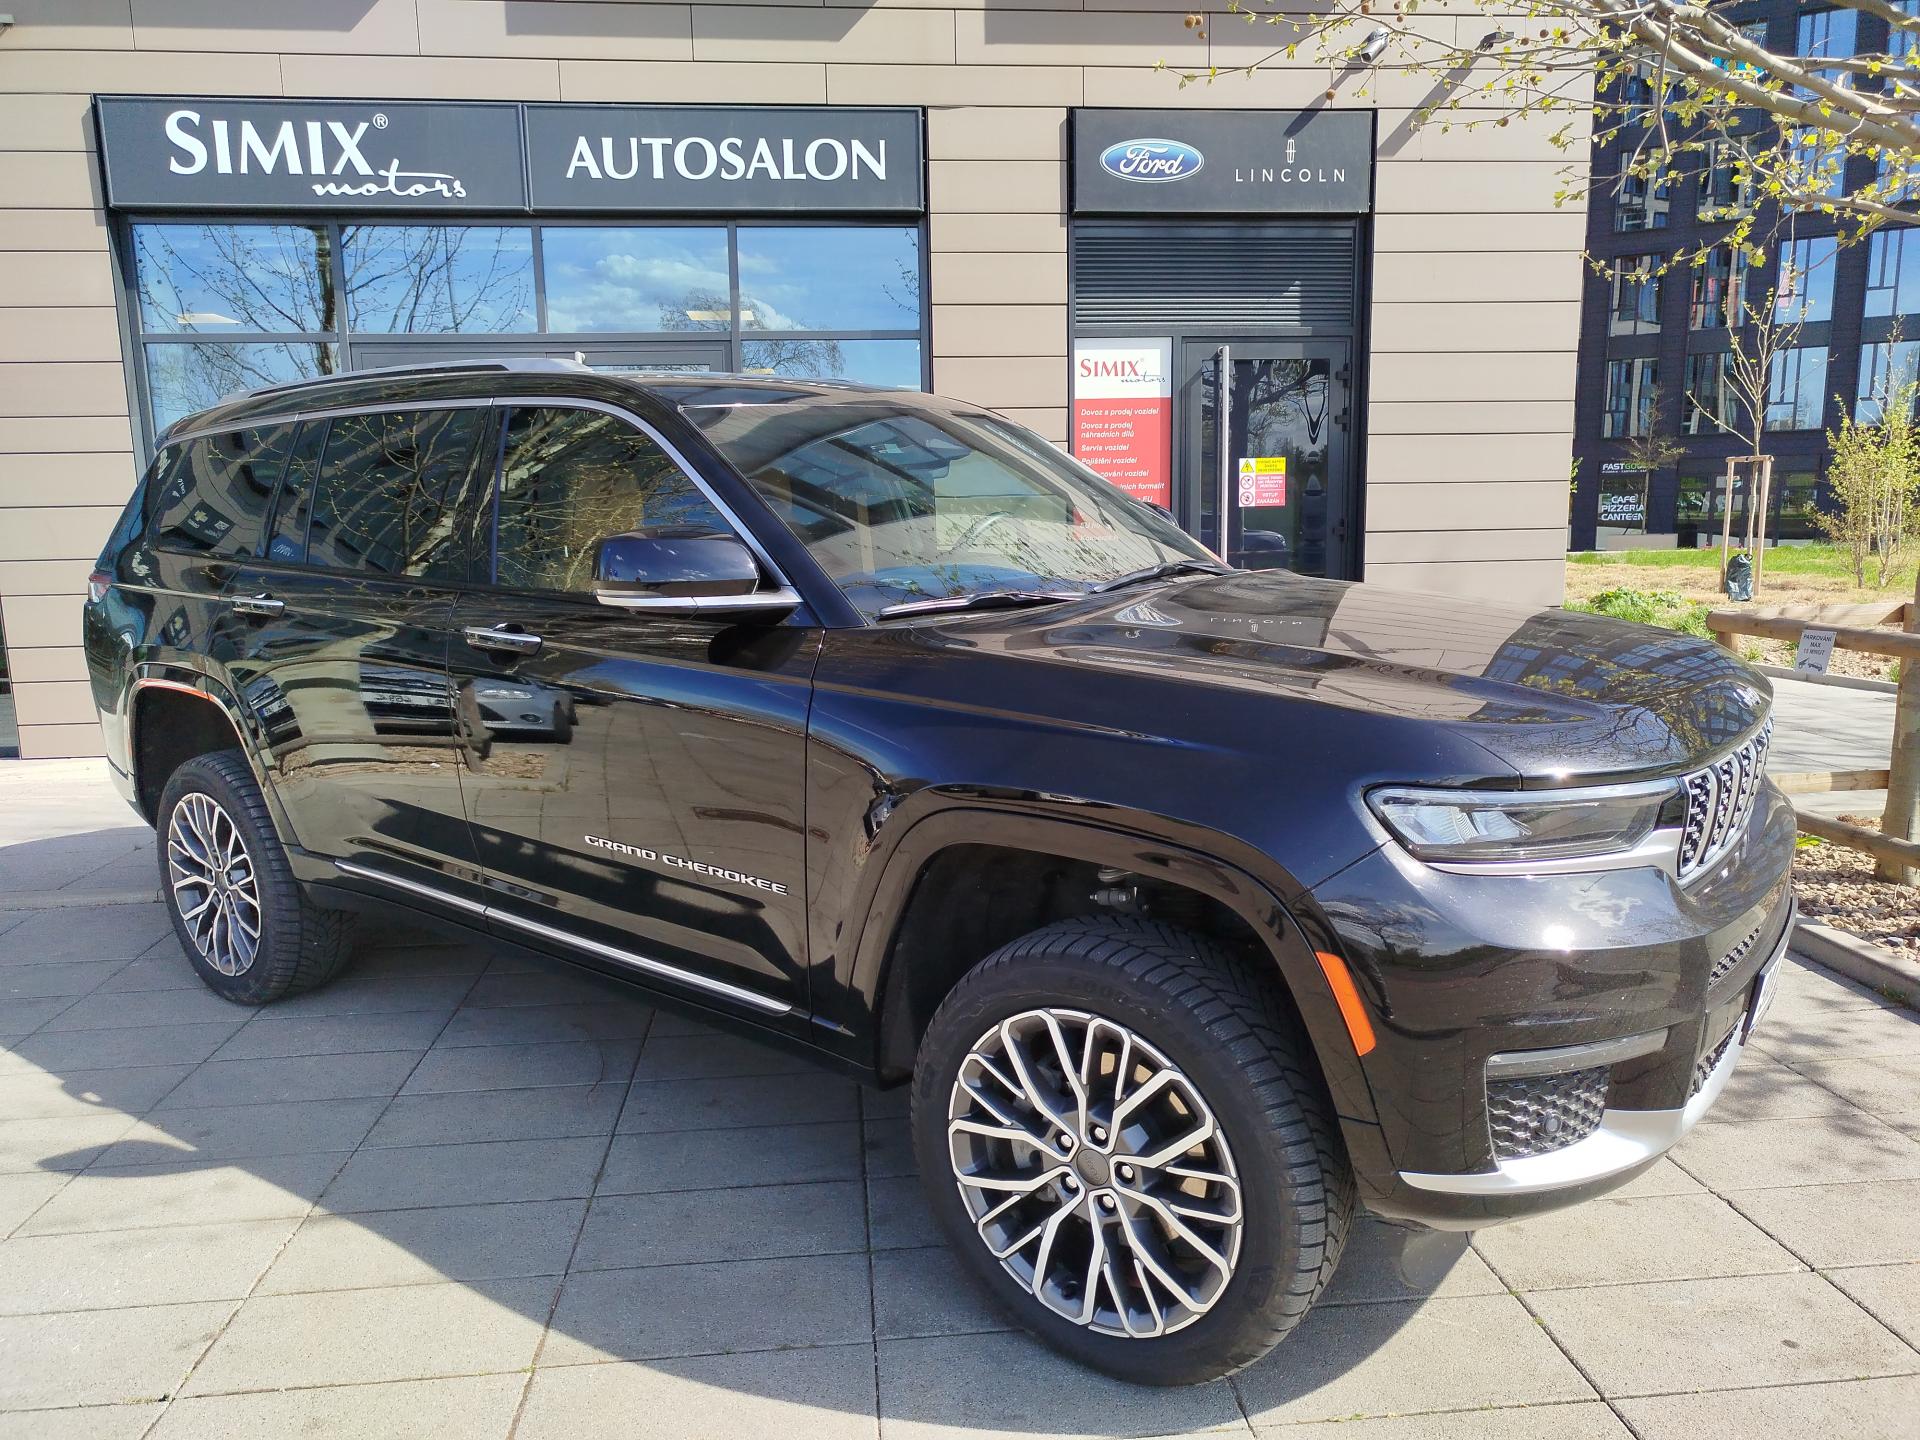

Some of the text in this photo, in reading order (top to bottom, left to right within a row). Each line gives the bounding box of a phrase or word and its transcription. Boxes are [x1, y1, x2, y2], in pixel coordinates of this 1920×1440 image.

[566, 135, 886, 180] AUTOSALON
[1119, 145, 1184, 174] Ford
[312, 158, 467, 198] motors
[1235, 168, 1346, 183] LINCOLN
[1120, 369, 1166, 383] motors
[1081, 408, 1103, 416] Dovoz
[1110, 408, 1133, 417] prodej
[1134, 407, 1159, 415] vozidel
[1110, 421, 1133, 430] prodej
[1121, 430, 1135, 438] dílů
[1104, 443, 1130, 451] vozidel
[1081, 457, 1112, 466] Pojištění
[1611, 495, 1636, 504] CAFE
[1601, 504, 1645, 512] PIZZERIA
[1601, 513, 1645, 521] CANTEEN
[1803, 633, 1833, 642] PARKOVÁNÍ
[584, 834, 789, 896] GRAND CHEROKEE
